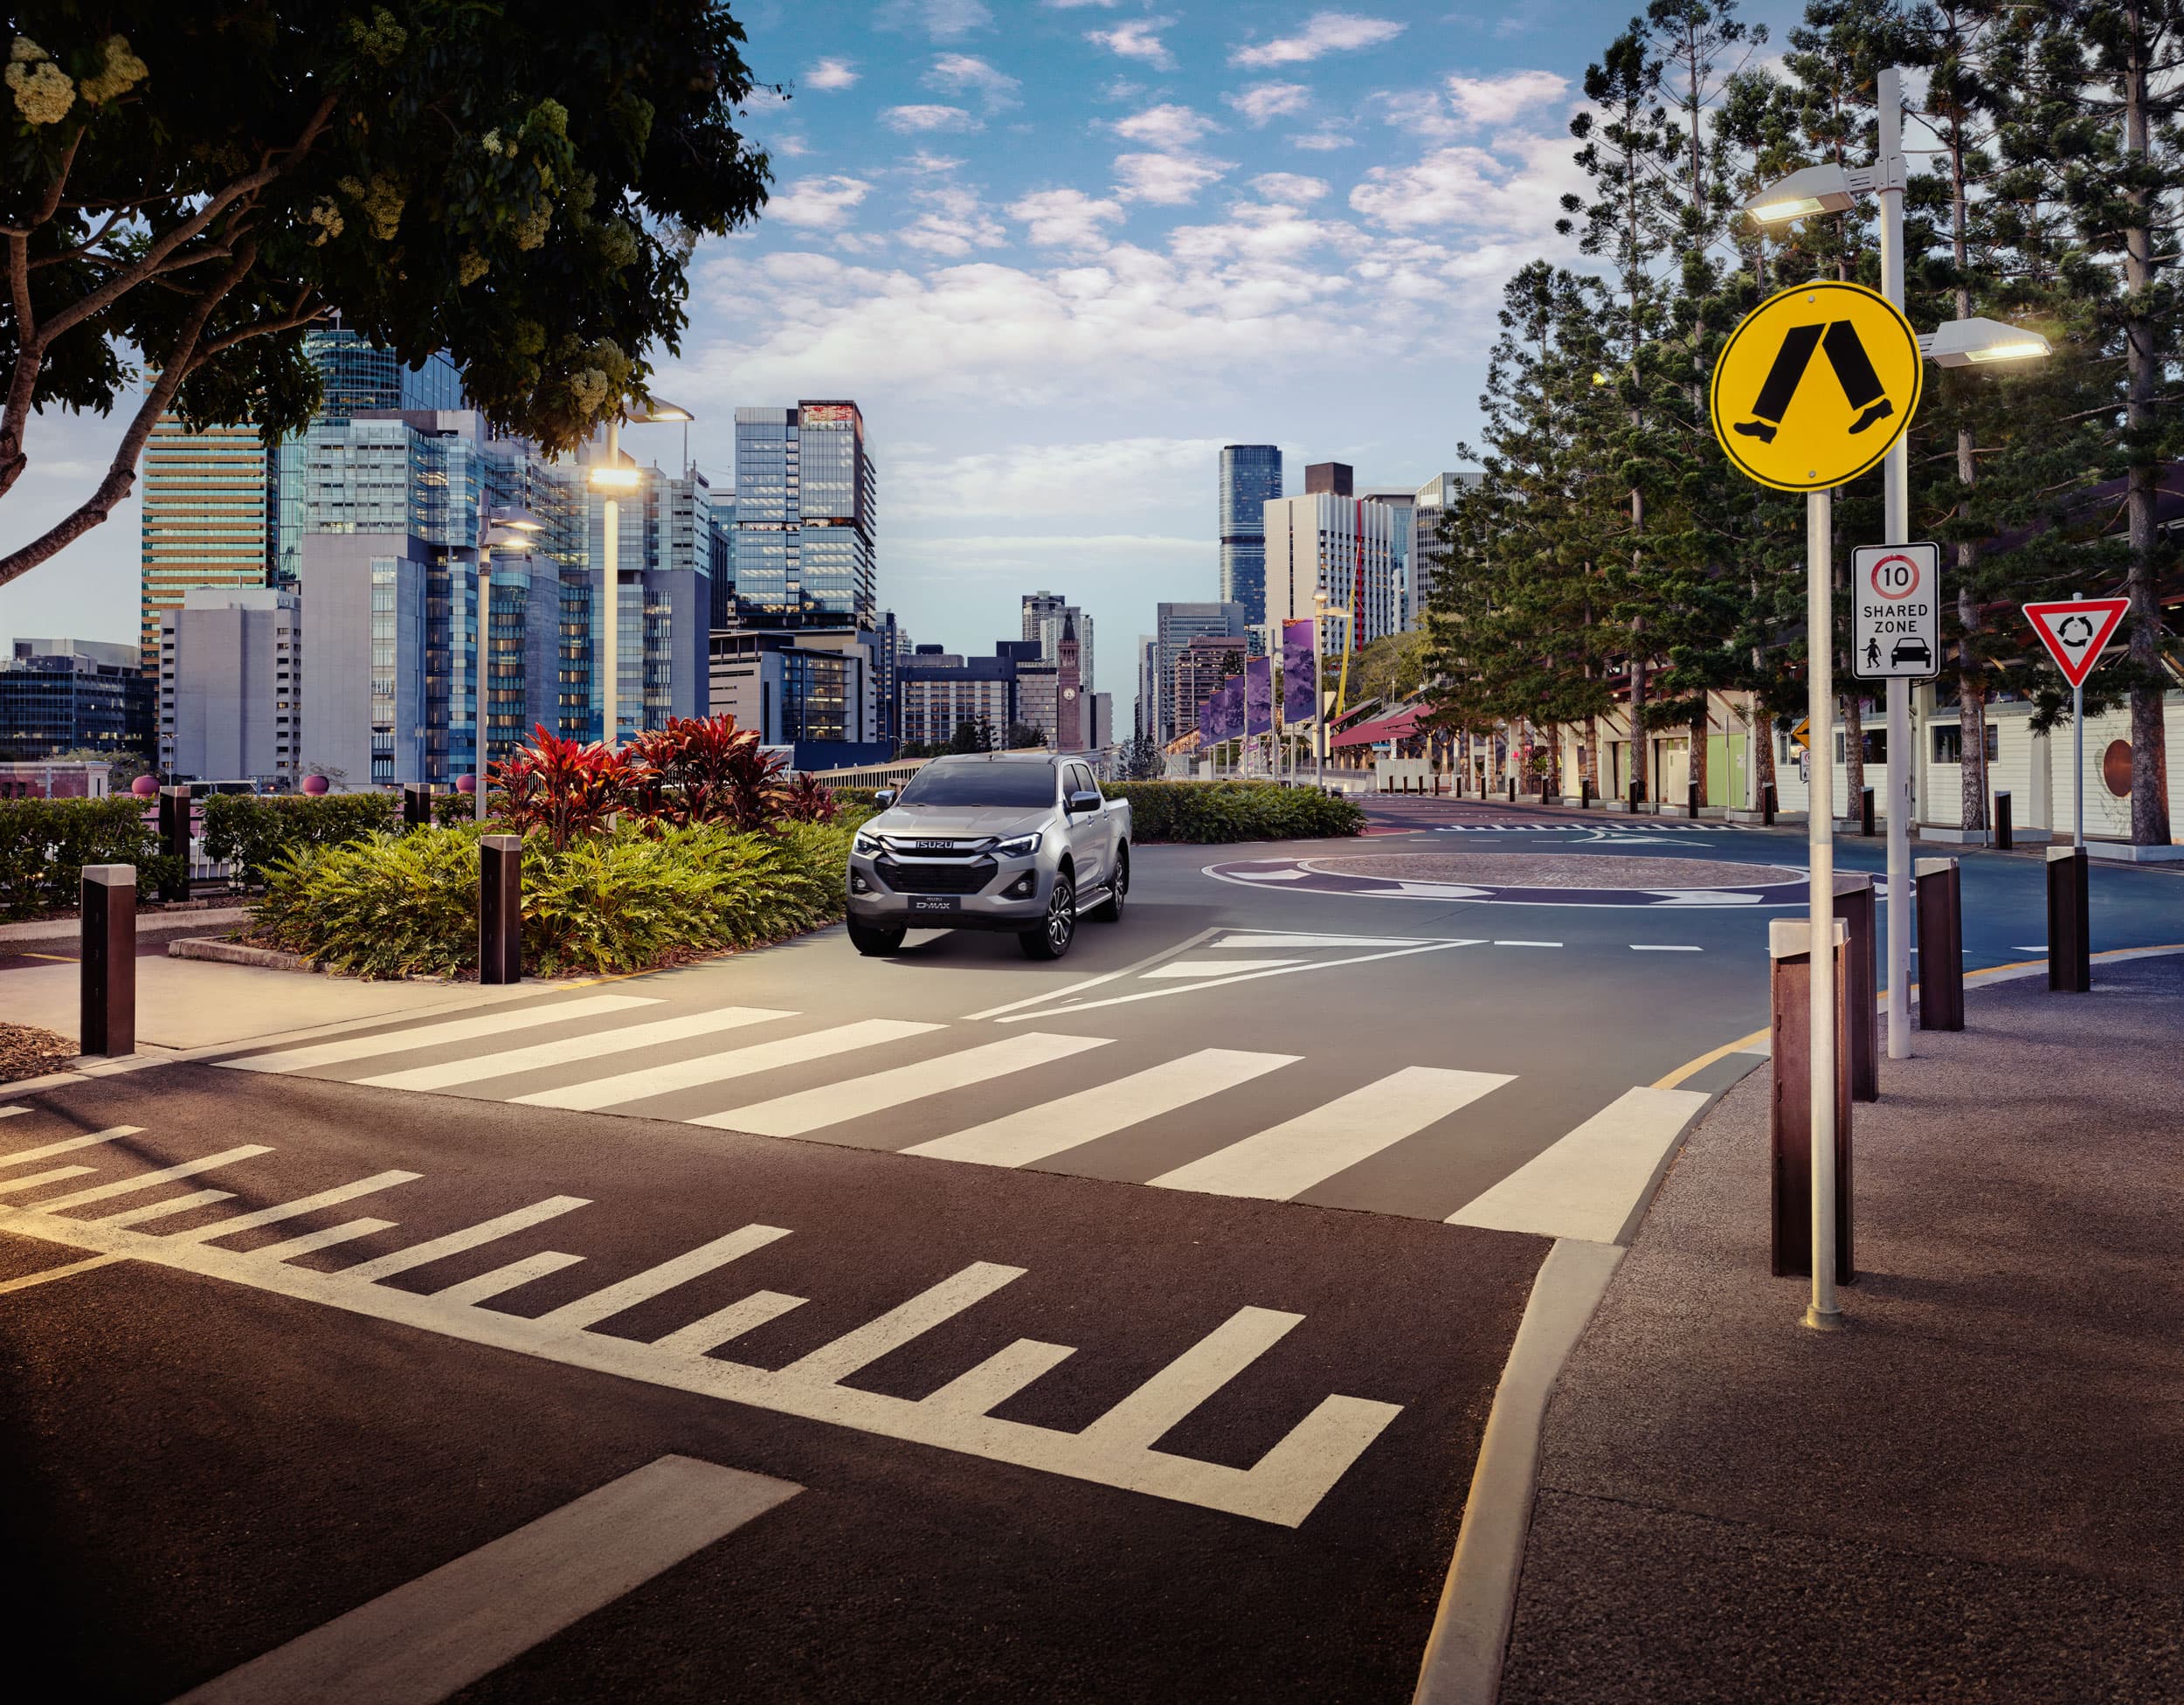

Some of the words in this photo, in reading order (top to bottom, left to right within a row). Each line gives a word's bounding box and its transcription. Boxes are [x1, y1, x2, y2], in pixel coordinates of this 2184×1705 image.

[1884, 567, 1909, 586] 10
[1863, 604, 1928, 618] SHARED
[1874, 620, 1917, 633] ZONE
[916, 840, 953, 849] ISUZU
